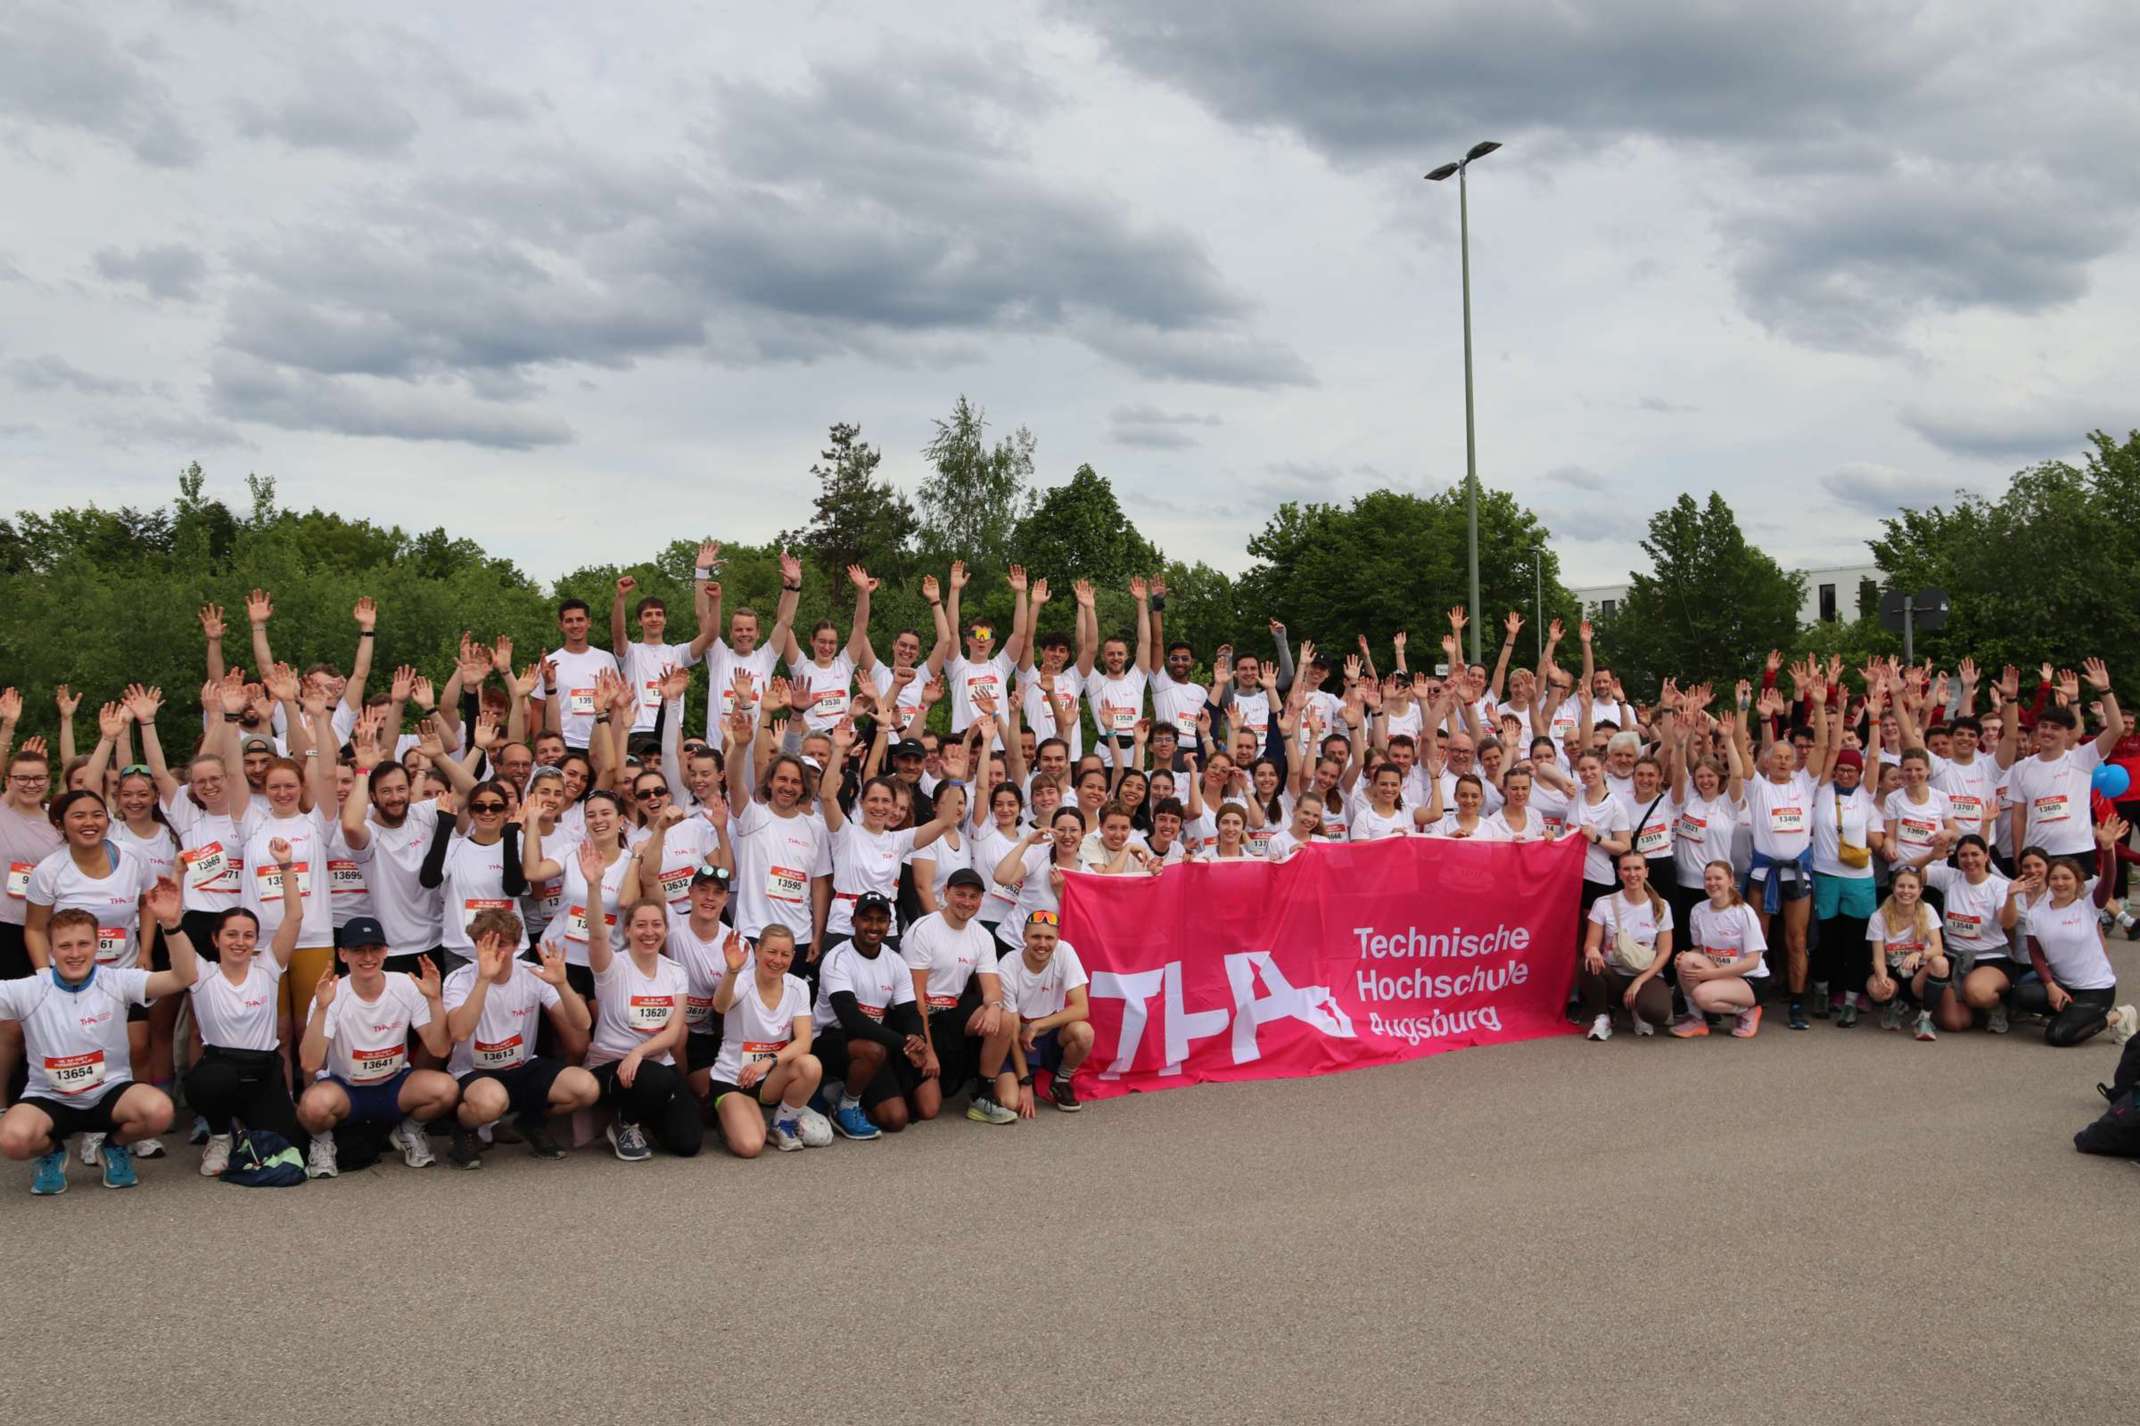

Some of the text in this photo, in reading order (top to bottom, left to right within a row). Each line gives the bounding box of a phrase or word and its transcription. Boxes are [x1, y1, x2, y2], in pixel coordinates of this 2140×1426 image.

[662, 878, 689, 892] 13632
[777, 878, 802, 890] 13595
[1353, 924, 1530, 959] Technische
[1356, 960, 1528, 1001] Hochschule
[640, 1008, 667, 1018] 13620
[1089, 951, 1358, 1080] THA
[1369, 1006, 1503, 1046] Augsburg
[484, 1048, 514, 1061] 13613
[363, 1058, 394, 1070] 13641
[56, 1065, 94, 1081] 13654
